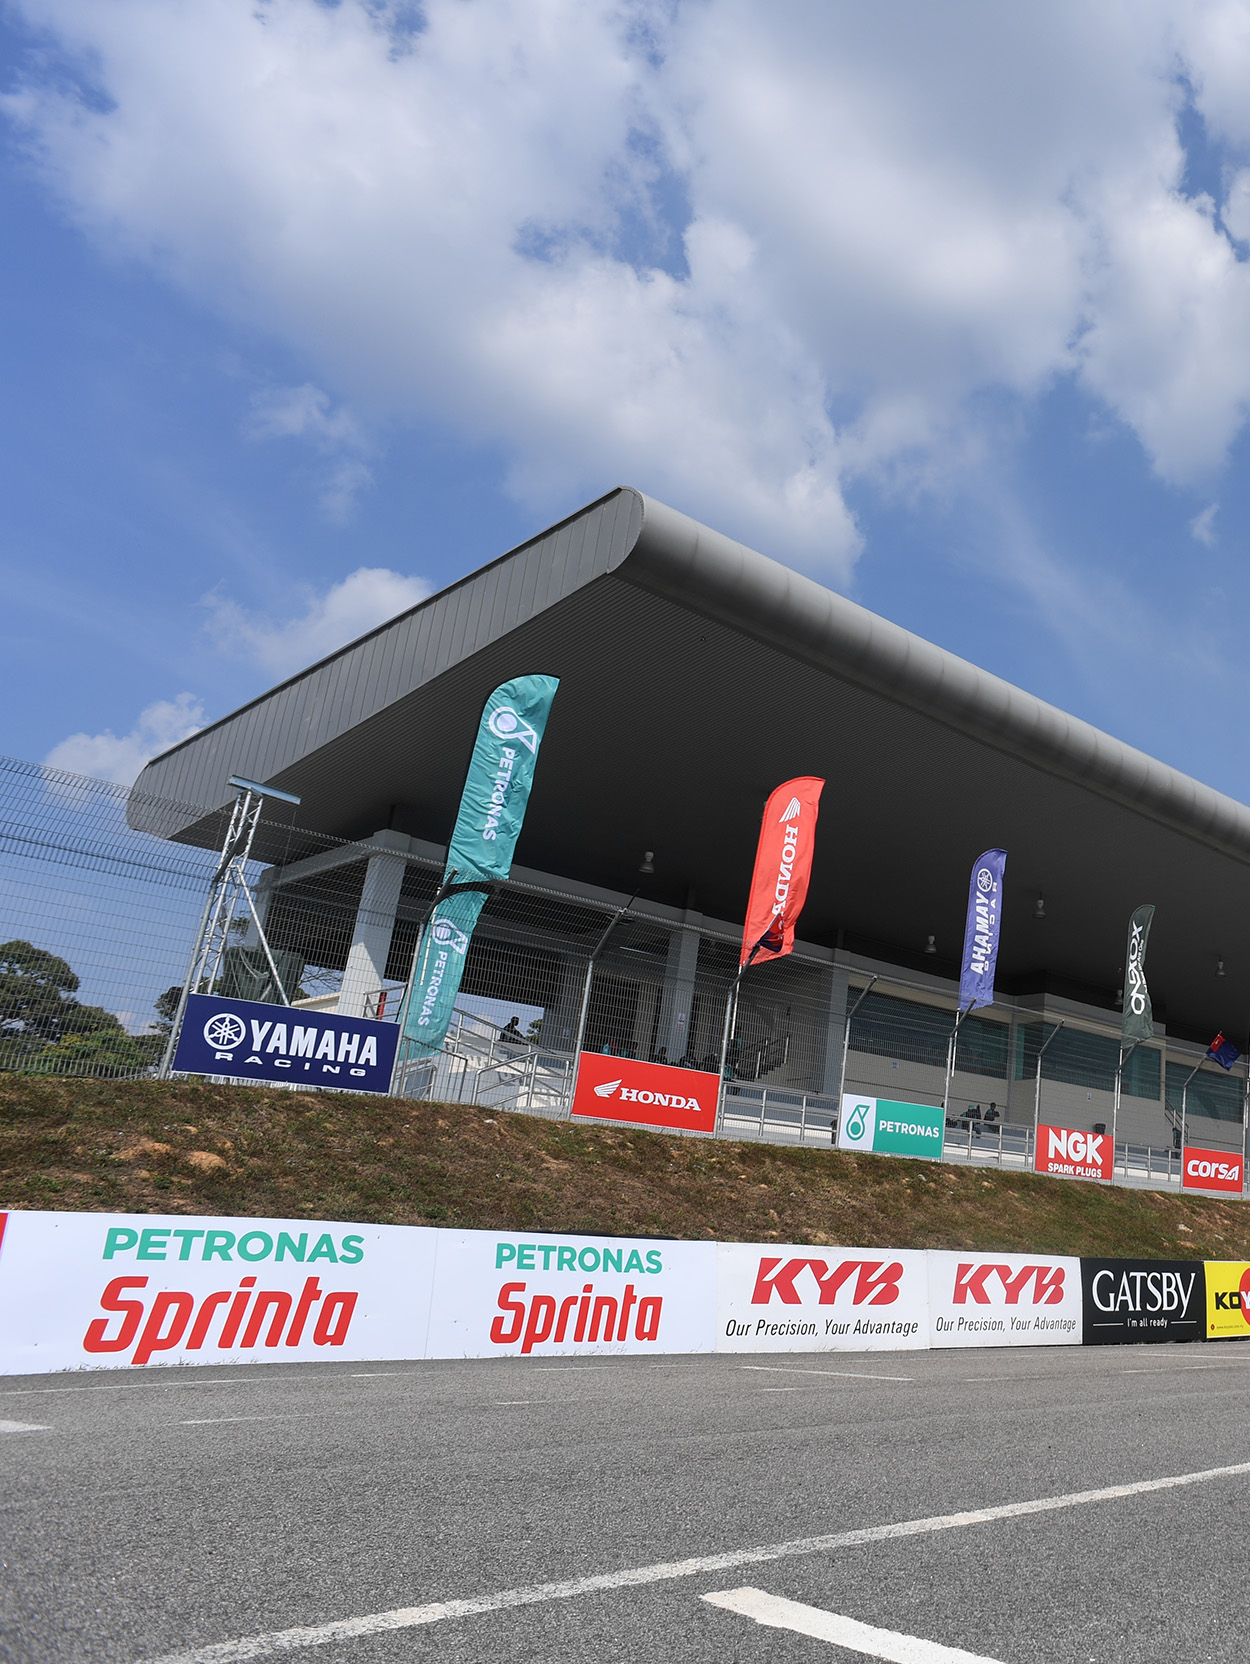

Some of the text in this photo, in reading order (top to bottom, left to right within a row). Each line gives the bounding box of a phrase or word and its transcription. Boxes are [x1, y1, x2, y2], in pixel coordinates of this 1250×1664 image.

[482, 745, 516, 842] PETRONAS
[417, 951, 449, 1027] PETRONAS
[250, 1019, 377, 1067] YAMAHA
[214, 1051, 367, 1077] RACING
[619, 1087, 702, 1112] HONDA
[878, 1119, 940, 1139] PETRONAS
[1048, 1128, 1104, 1166] NGK
[1047, 1162, 1102, 1178] SPARK PLUGS
[102, 1227, 365, 1265] PETRONAS
[495, 1242, 663, 1275] PETRONAS
[750, 1257, 904, 1306] KYB
[952, 1263, 1066, 1305] KYB
[1092, 1269, 1196, 1319] GATSBY
[82, 1275, 359, 1365] Sprinta
[489, 1282, 664, 1354] Sprinta
[725, 1319, 919, 1338] Our Precision, Your Advantage
[935, 1316, 1077, 1333] Our Precision, Your Advantage
[1127, 1317, 1169, 1329] I'm all ready
